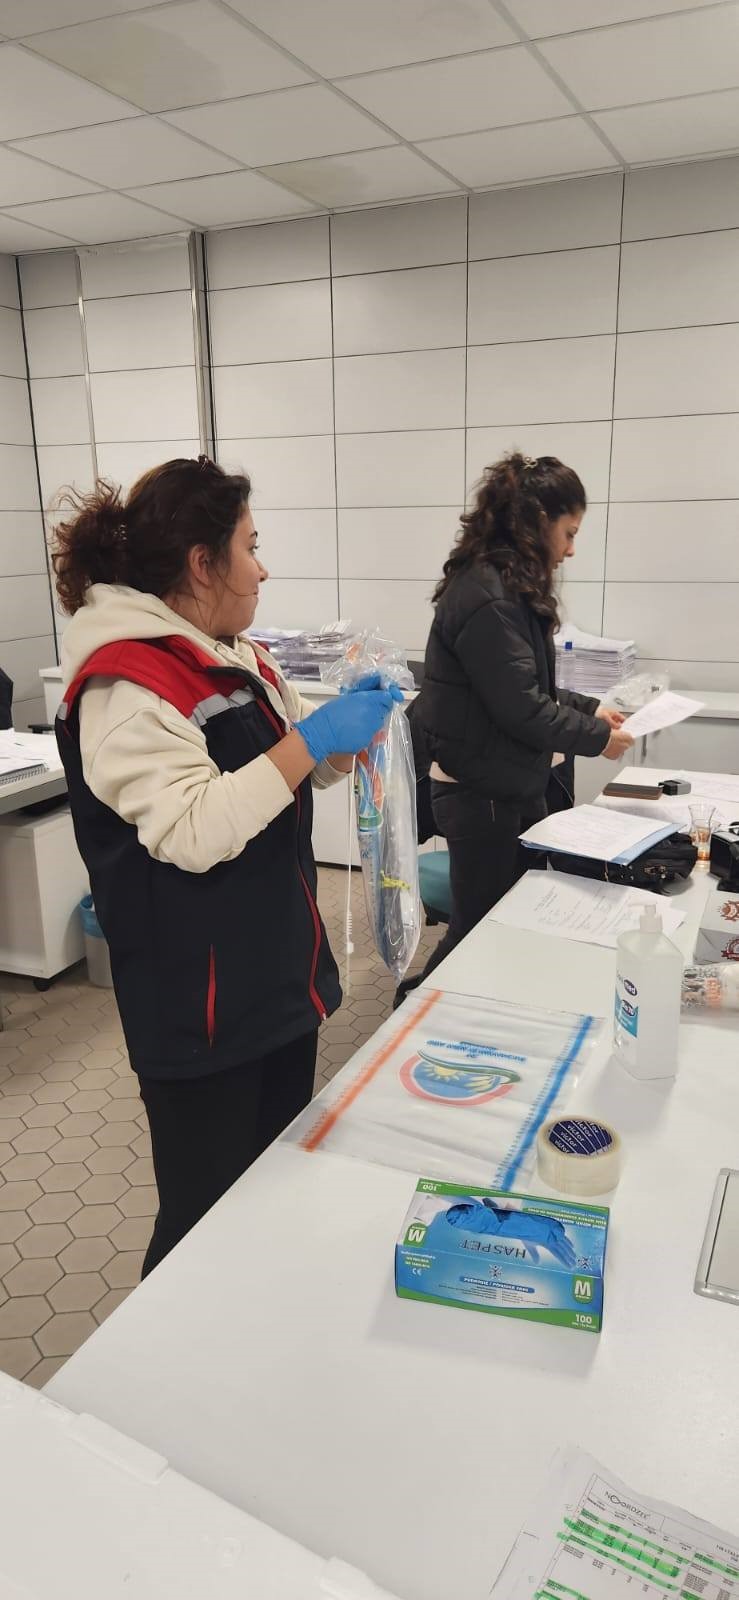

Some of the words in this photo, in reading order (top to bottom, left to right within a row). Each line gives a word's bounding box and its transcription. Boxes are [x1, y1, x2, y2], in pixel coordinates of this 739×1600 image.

[560, 1131, 577, 1147] victor
[567, 1125, 584, 1141] victor
[554, 1139, 570, 1153] victor
[422, 1182, 438, 1191] 100
[407, 1227, 426, 1243] M
[458, 1238, 527, 1259] HASPET
[574, 1279, 592, 1297] M
[575, 1313, 593, 1325] 100
